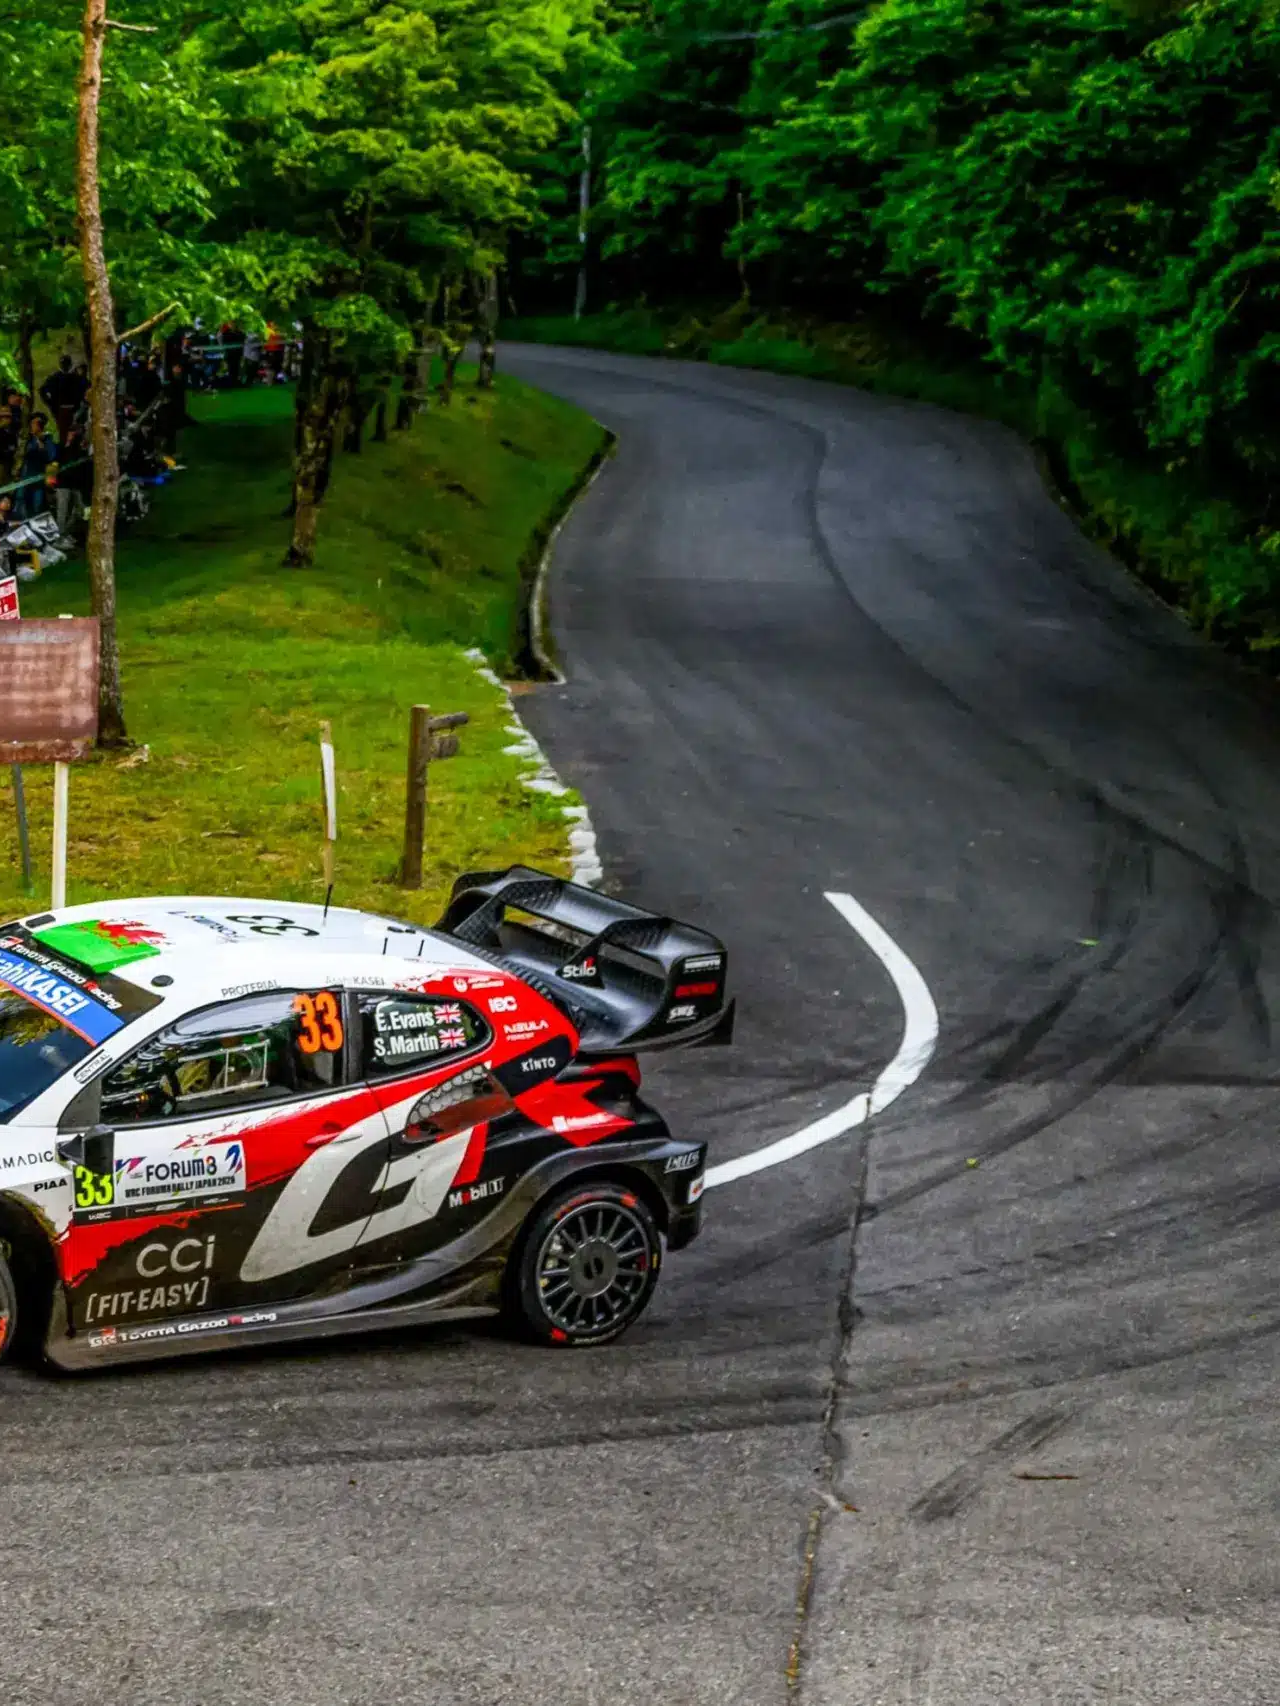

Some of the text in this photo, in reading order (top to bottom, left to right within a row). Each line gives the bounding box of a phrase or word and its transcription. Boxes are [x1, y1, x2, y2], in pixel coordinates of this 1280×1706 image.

[12, 944, 51, 964] TOYOTA
[47, 960, 87, 984] GAZOO
[562, 957, 597, 979] Stilo
[220, 979, 282, 998] PROTERIAL
[291, 991, 344, 1053] 33
[375, 1008, 435, 1032] E.Evans
[374, 1032, 440, 1056] S.Martin
[146, 1155, 217, 1182] FORUM8
[33, 1178, 68, 1192] PIAA
[75, 1165, 113, 1208] 33
[448, 1187, 488, 1208] Mobil
[136, 1235, 216, 1278] CCi
[119, 1327, 176, 1342] TOYOTA
[177, 1319, 228, 1333] GAZOO
[228, 1312, 277, 1325] Racing
